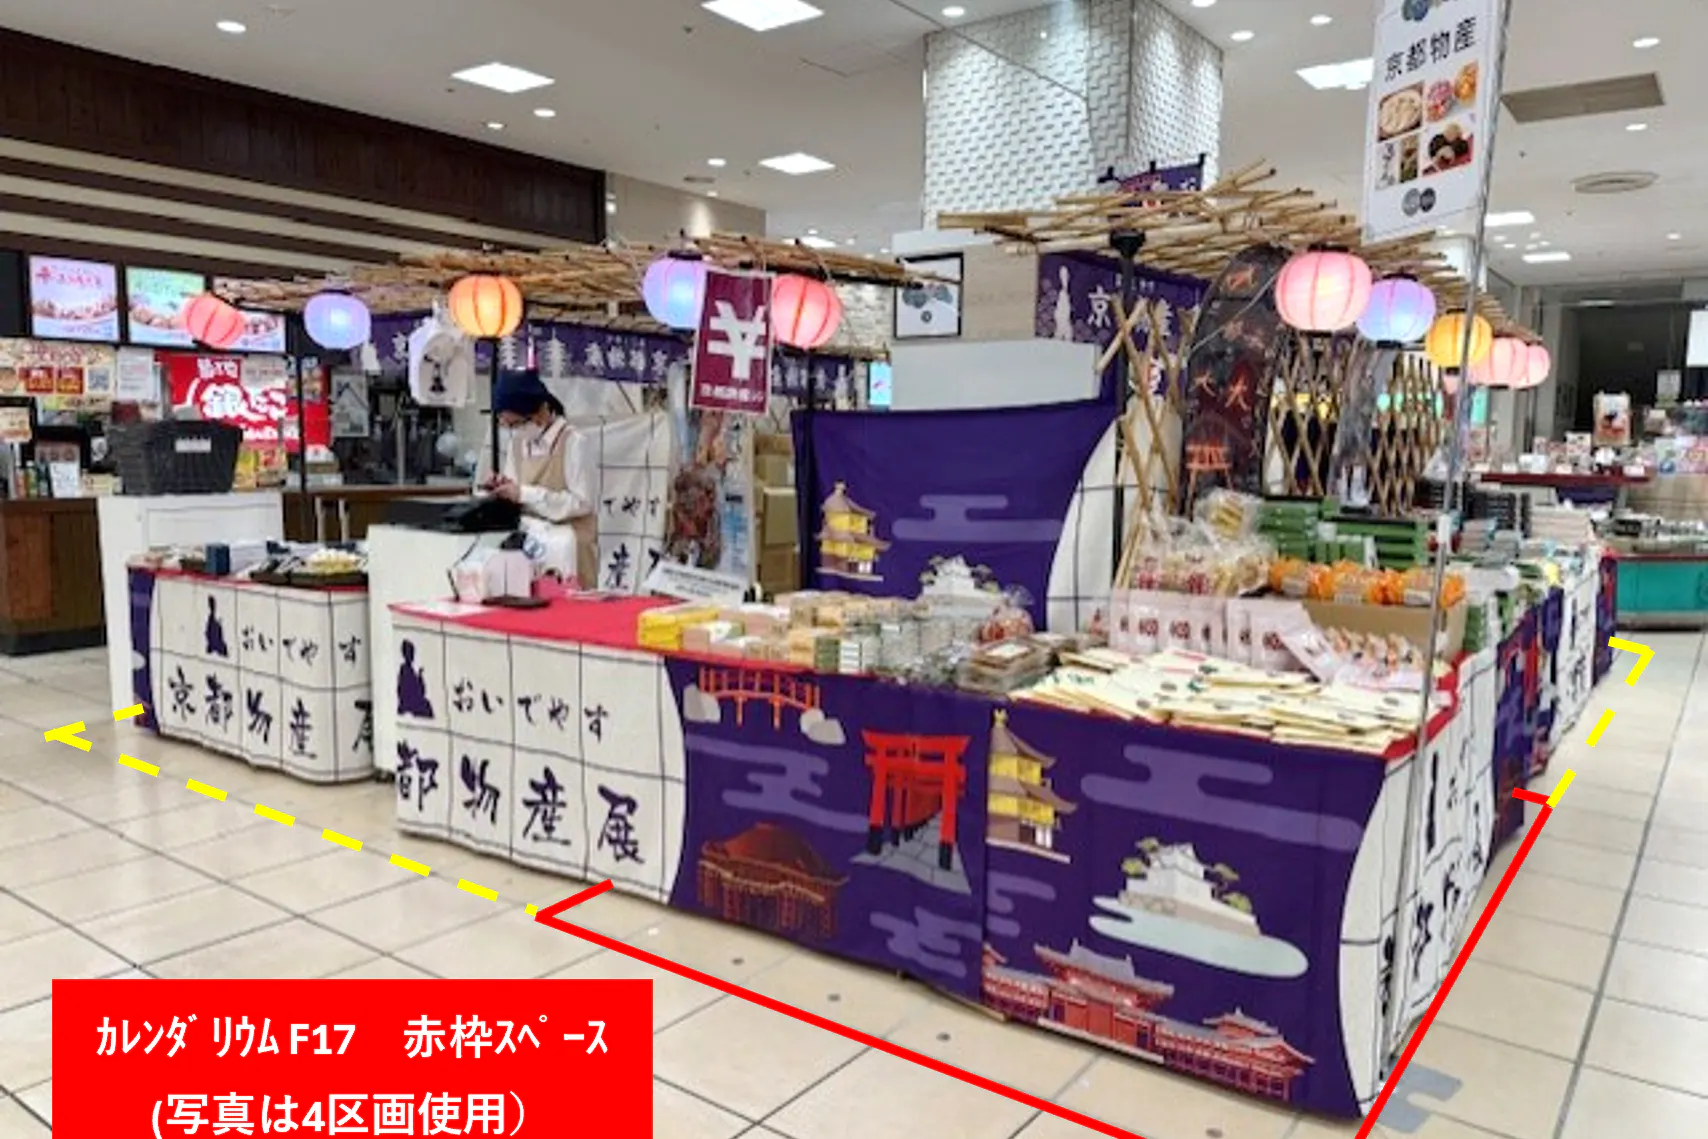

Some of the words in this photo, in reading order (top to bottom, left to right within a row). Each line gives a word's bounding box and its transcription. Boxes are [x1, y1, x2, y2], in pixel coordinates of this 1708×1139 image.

[1385, 17, 1476, 82] 京都物産
[241, 625, 362, 665] おいでやす
[452, 677, 609, 742] おいでやす
